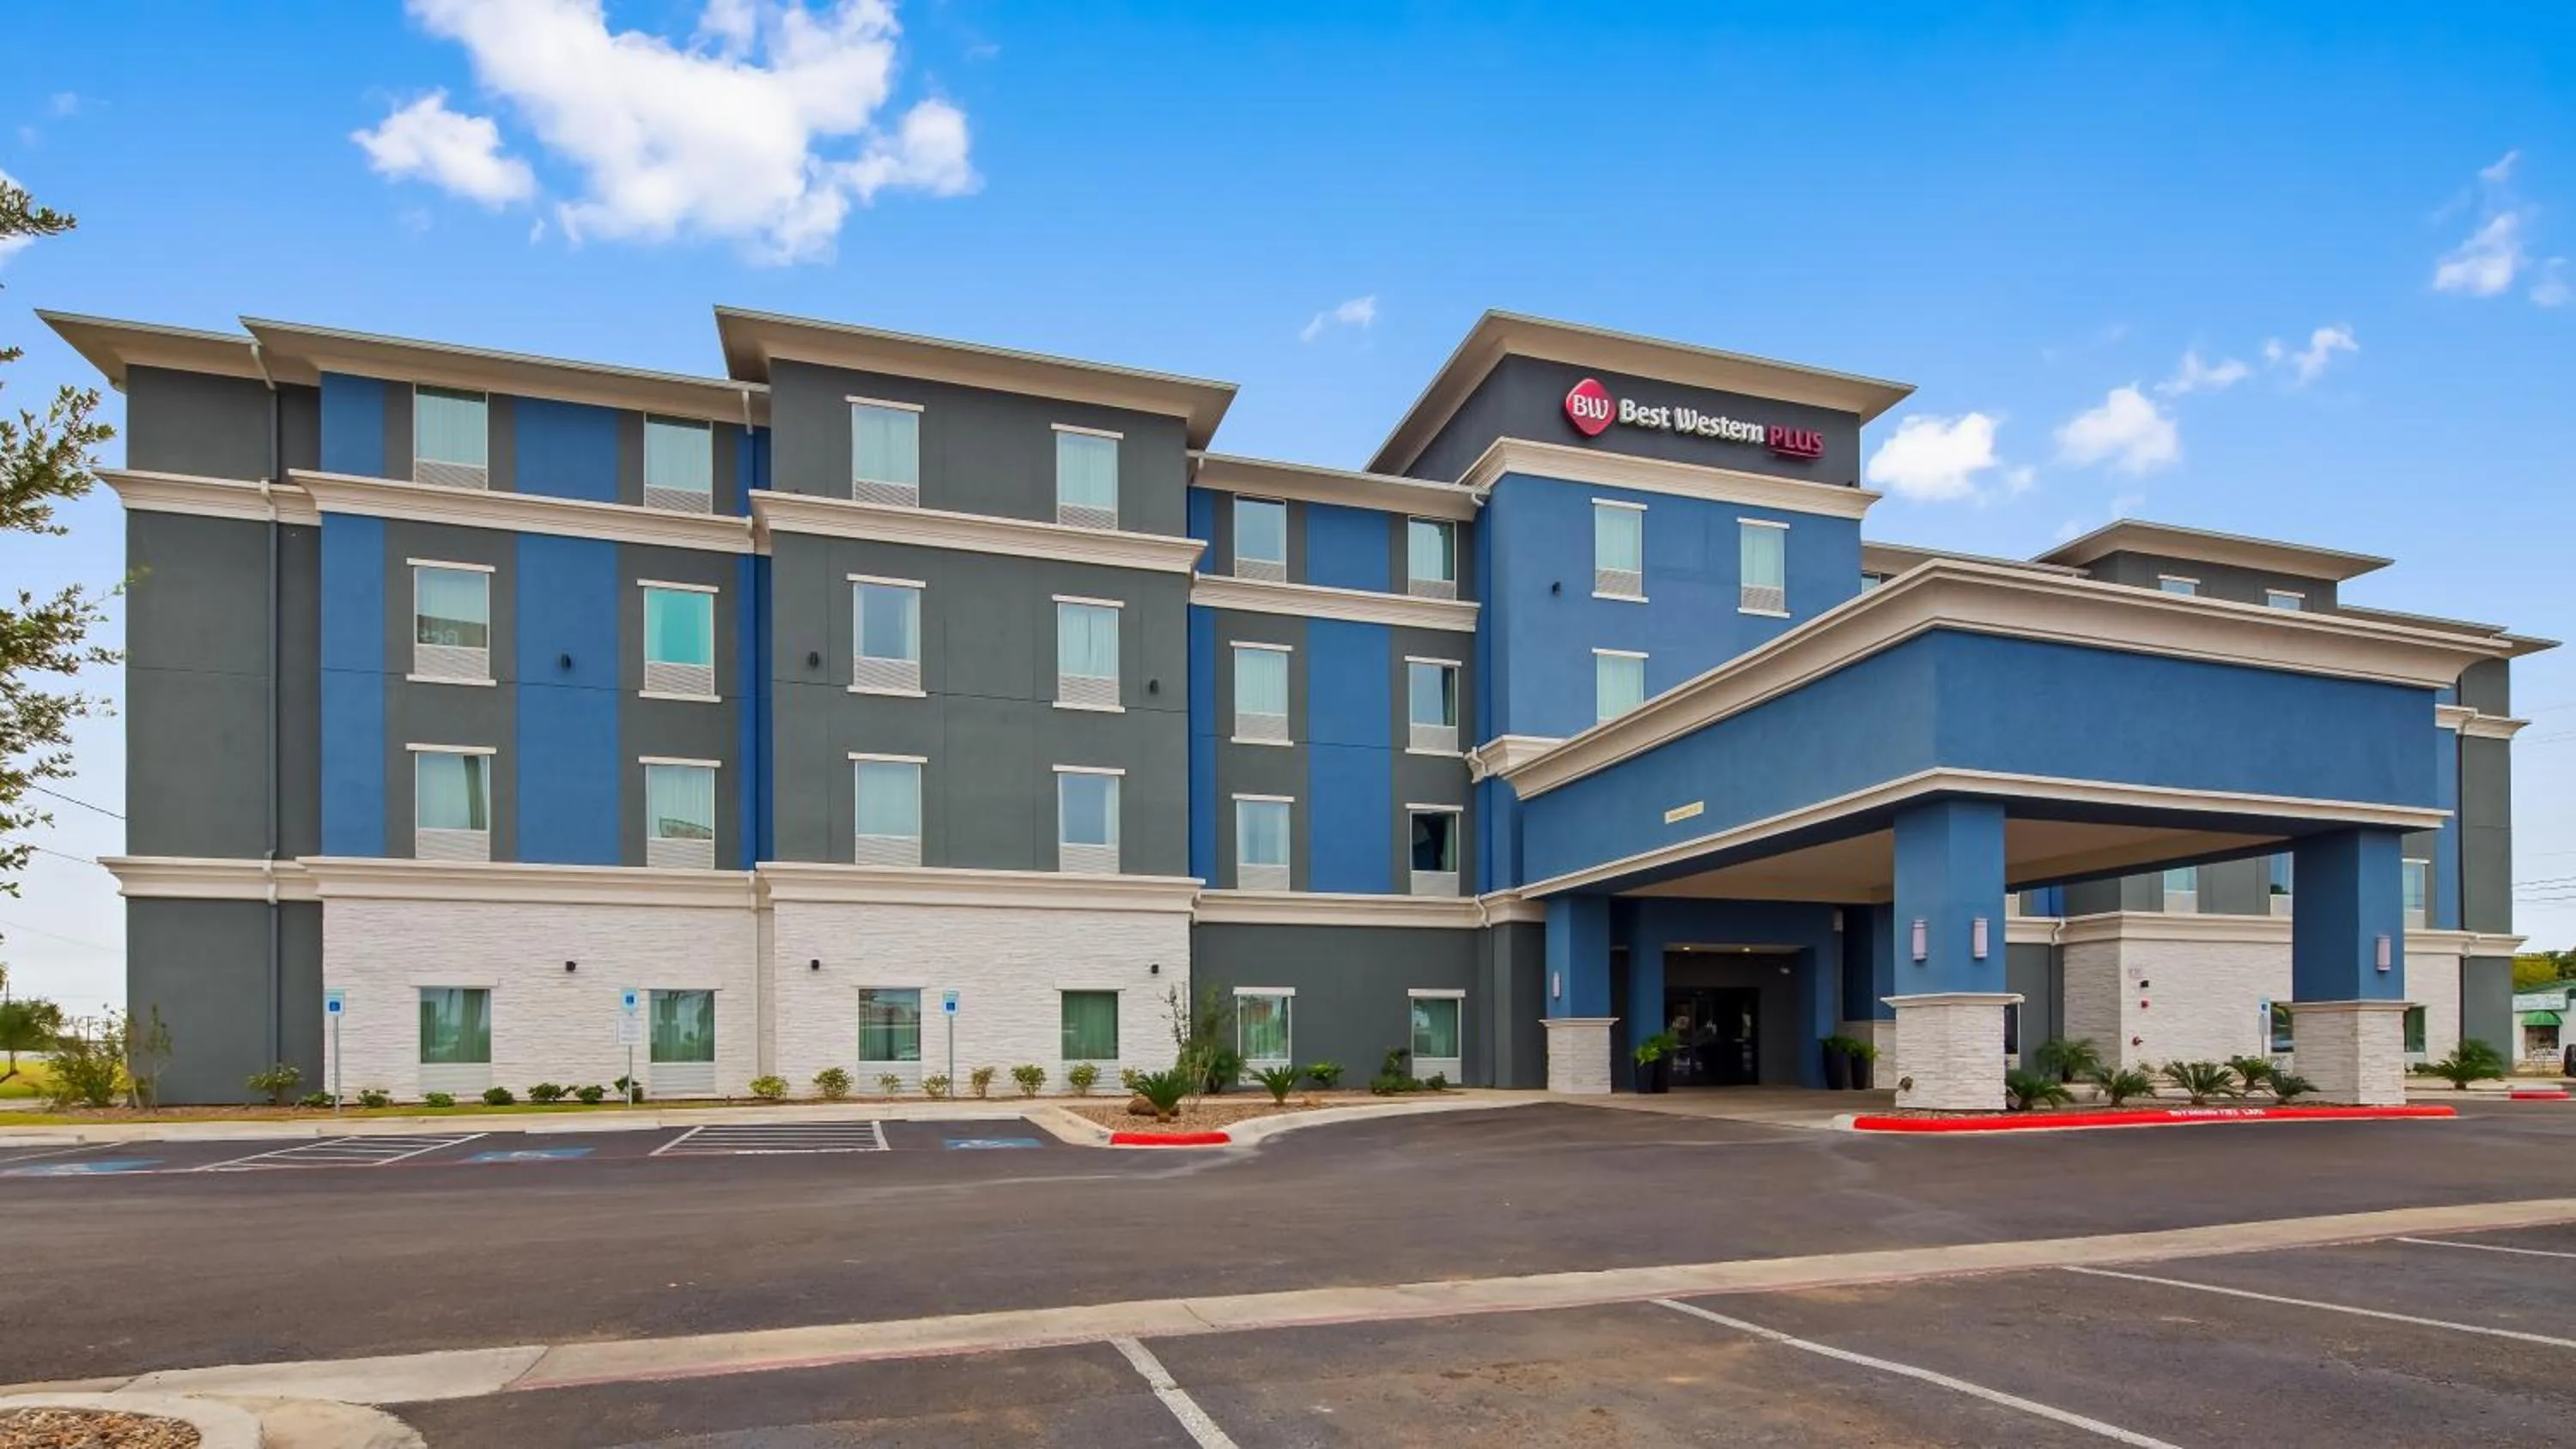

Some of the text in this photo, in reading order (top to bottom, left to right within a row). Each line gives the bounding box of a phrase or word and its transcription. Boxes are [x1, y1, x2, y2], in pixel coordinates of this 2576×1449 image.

[1573, 394, 1609, 420] BW
[1619, 398, 1825, 455] Best Western PLUS
